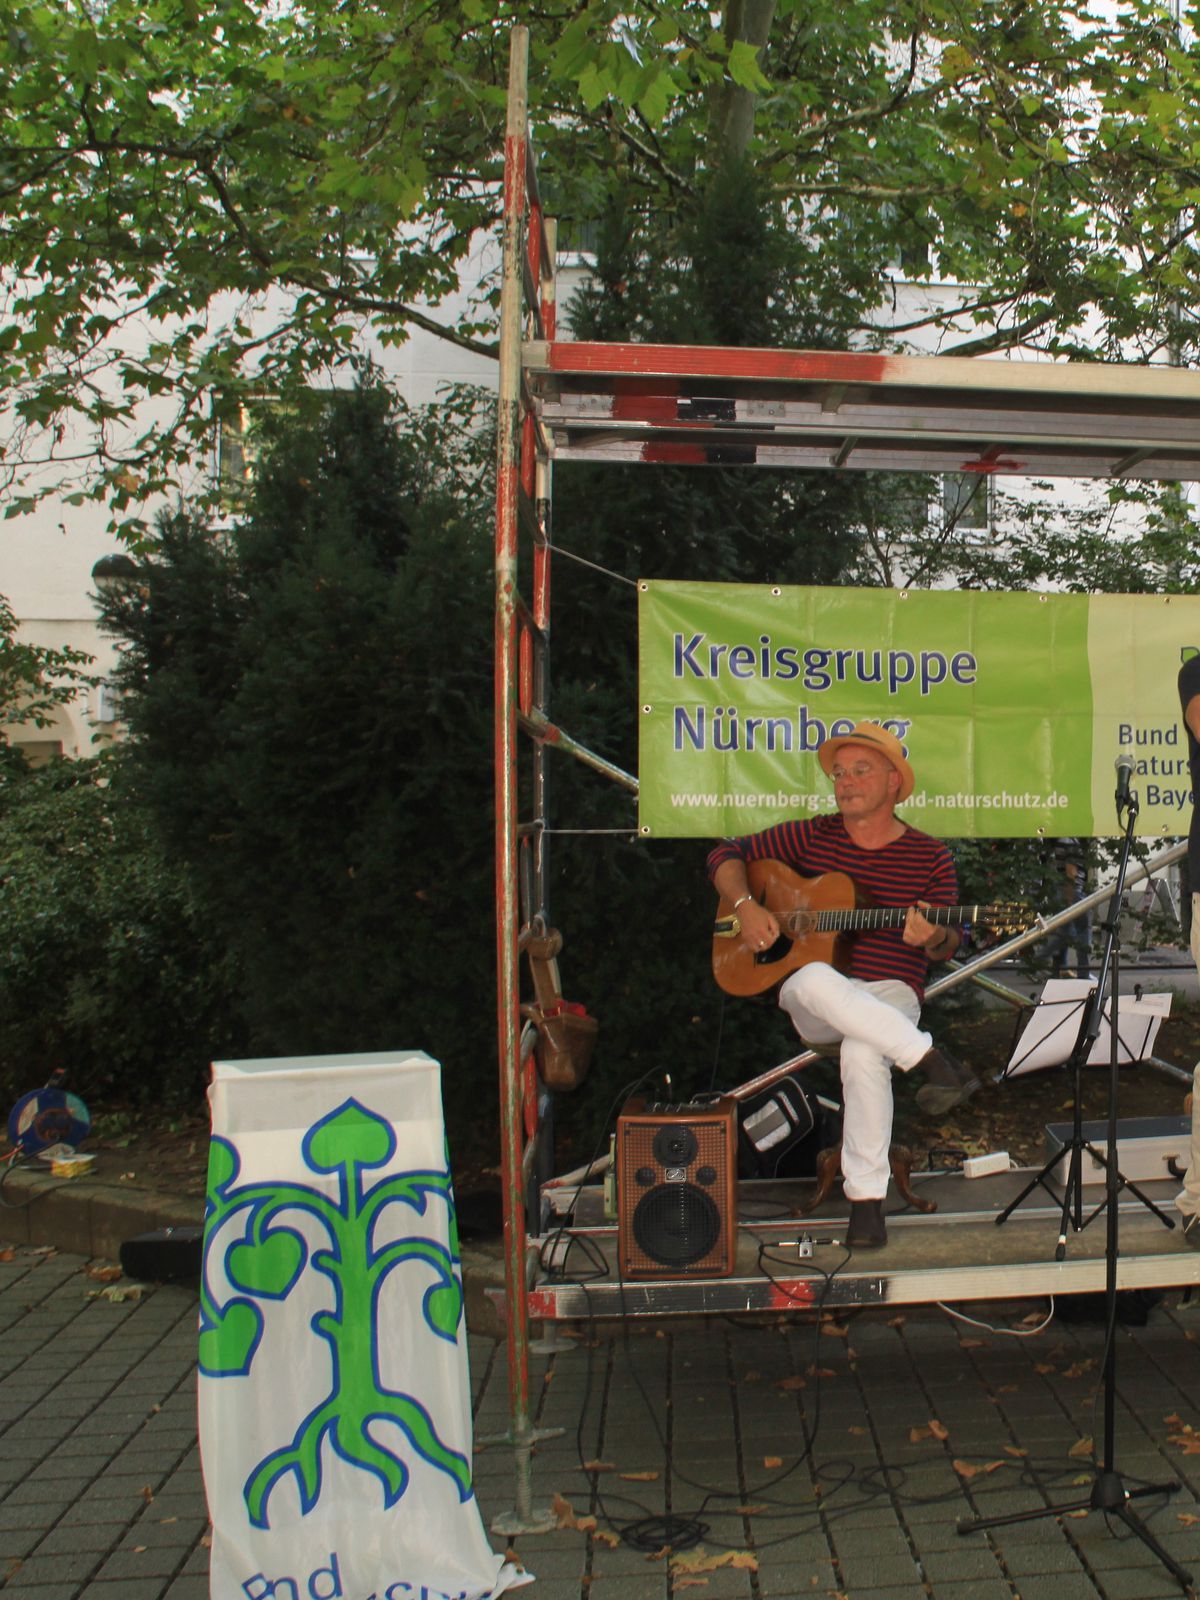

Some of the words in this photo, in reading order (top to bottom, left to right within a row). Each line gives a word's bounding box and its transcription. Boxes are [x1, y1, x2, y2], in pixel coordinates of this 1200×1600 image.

[673, 632, 978, 696] Kreisgruppe
[673, 704, 911, 760] Nürnbeg
[1119, 723, 1178, 746] Bund
